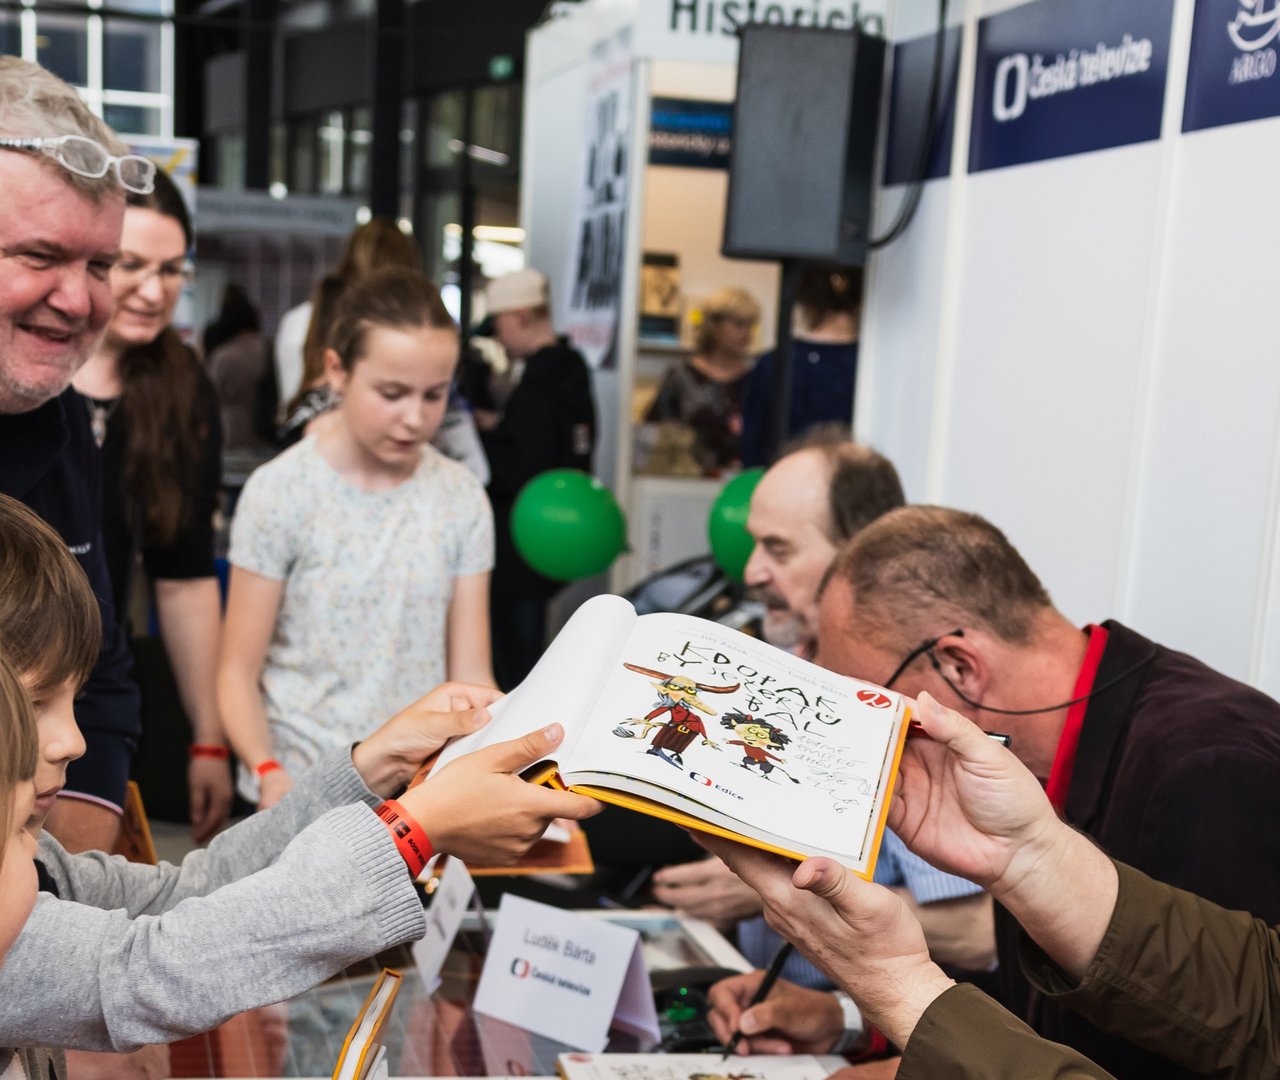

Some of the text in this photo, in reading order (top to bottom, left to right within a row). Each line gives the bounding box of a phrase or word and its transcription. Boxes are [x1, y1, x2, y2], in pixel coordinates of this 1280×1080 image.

[1079, 34, 1152, 86] televize
[1229, 47, 1277, 84] ARGO
[715, 784, 744, 800] Edice
